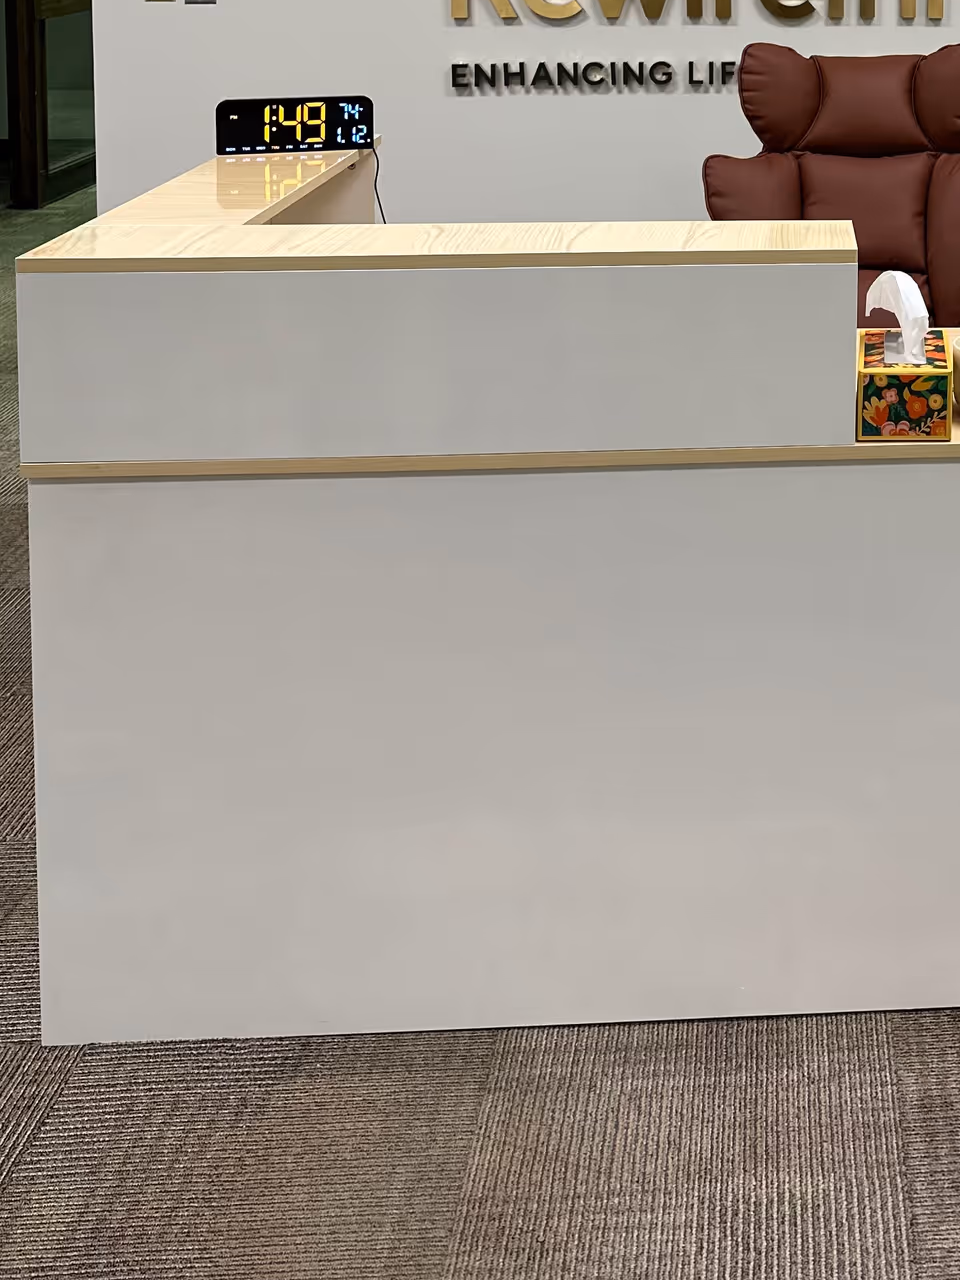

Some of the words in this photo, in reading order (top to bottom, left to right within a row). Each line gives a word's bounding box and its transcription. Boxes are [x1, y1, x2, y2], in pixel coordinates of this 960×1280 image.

[451, 61, 673, 88] ENHANCING
[688, 61, 737, 87] LIF
[264, 102, 326, 143] 1:49
